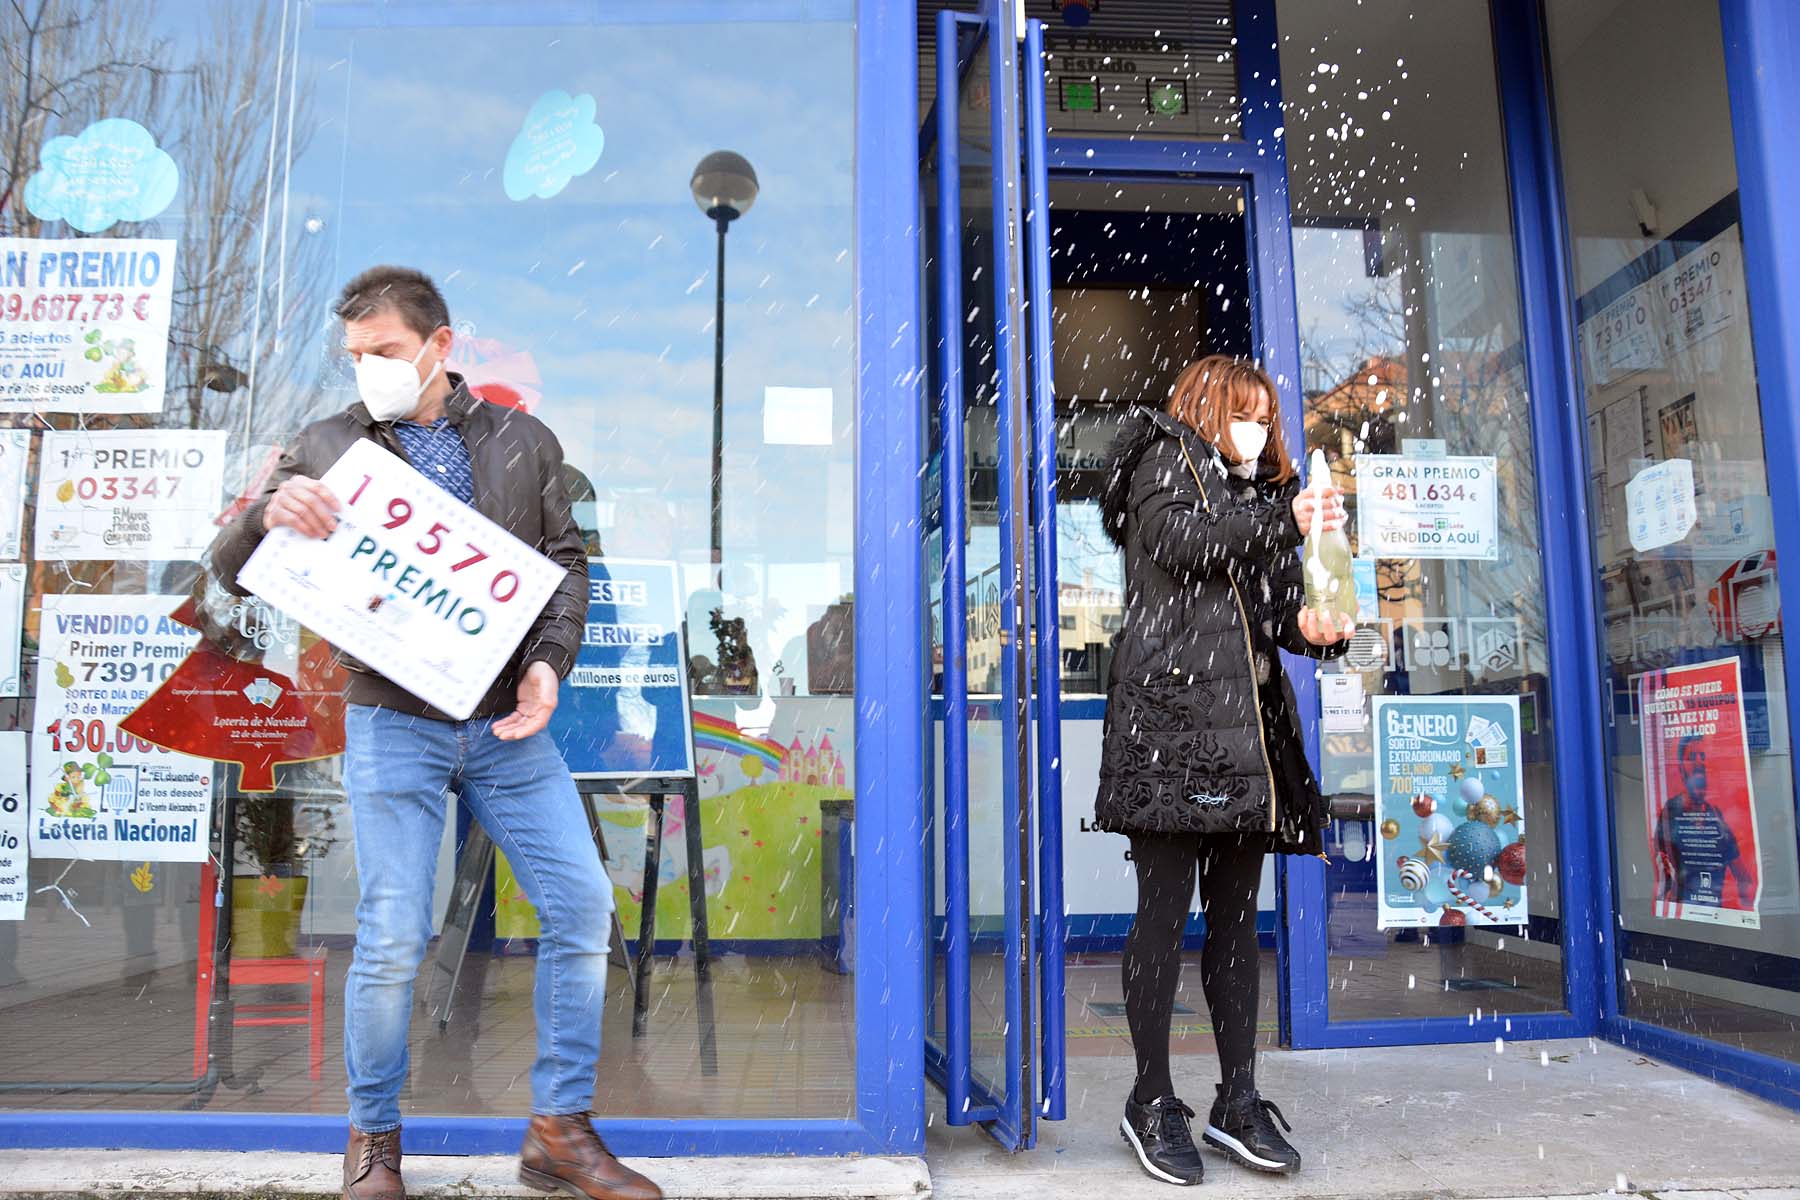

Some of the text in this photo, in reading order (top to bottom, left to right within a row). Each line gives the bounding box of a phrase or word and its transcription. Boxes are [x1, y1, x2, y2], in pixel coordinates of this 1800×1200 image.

[1062, 57, 1137, 74] Estado
[38, 251, 161, 288] PREMIO
[1669, 274, 1713, 314] 03347
[133, 293, 151, 321] €
[10, 331, 73, 345] aciertos
[20, 359, 65, 379] AQUÍ
[93, 448, 204, 470] PREMIO
[1373, 466, 1480, 480] GRAN PREMIO
[76, 475, 182, 501] 03347
[1382, 483, 1477, 502] 481.634 €
[347, 474, 519, 603] 19570
[1380, 531, 1480, 544] VENDIDO AQUÍ
[351, 535, 486, 636] PREMIO
[590, 581, 642, 604] ESTE
[56, 614, 148, 635] VENDIDO
[581, 625, 660, 645] IERNES
[70, 641, 127, 658] Primer
[572, 670, 622, 684] Millones
[643, 671, 676, 684] euros
[65, 688, 108, 700] SORTEO
[1655, 680, 1722, 700] CÓMO SE PUEDE
[82, 703, 97, 716] de
[1644, 701, 1678, 715] QUERER
[1679, 700, 1685, 711] A
[1698, 693, 1736, 707] EQUIPOS
[213, 716, 307, 728] Lotería de Navidad
[1386, 708, 1400, 736] 6
[1403, 714, 1458, 737] ENERO
[1668, 713, 1679, 725] LA
[1681, 711, 1697, 723] VEZ
[1698, 710, 1705, 722] Y
[1706, 709, 1719, 720] NO
[251, 730, 288, 739] diciembre
[1664, 723, 1716, 738] ESTAR LOCO
[1388, 738, 1421, 750] SORTEO
[1389, 750, 1461, 763] EXTRAORDINARIO
[1389, 763, 1401, 776] DE
[1402, 763, 1411, 776] EL
[139, 788, 151, 798] de
[153, 788, 168, 798] los
[1390, 775, 1447, 795] 700 MILLONES
[39, 818, 197, 843] Lotería Nacional
[1080, 817, 1099, 833] Lo
